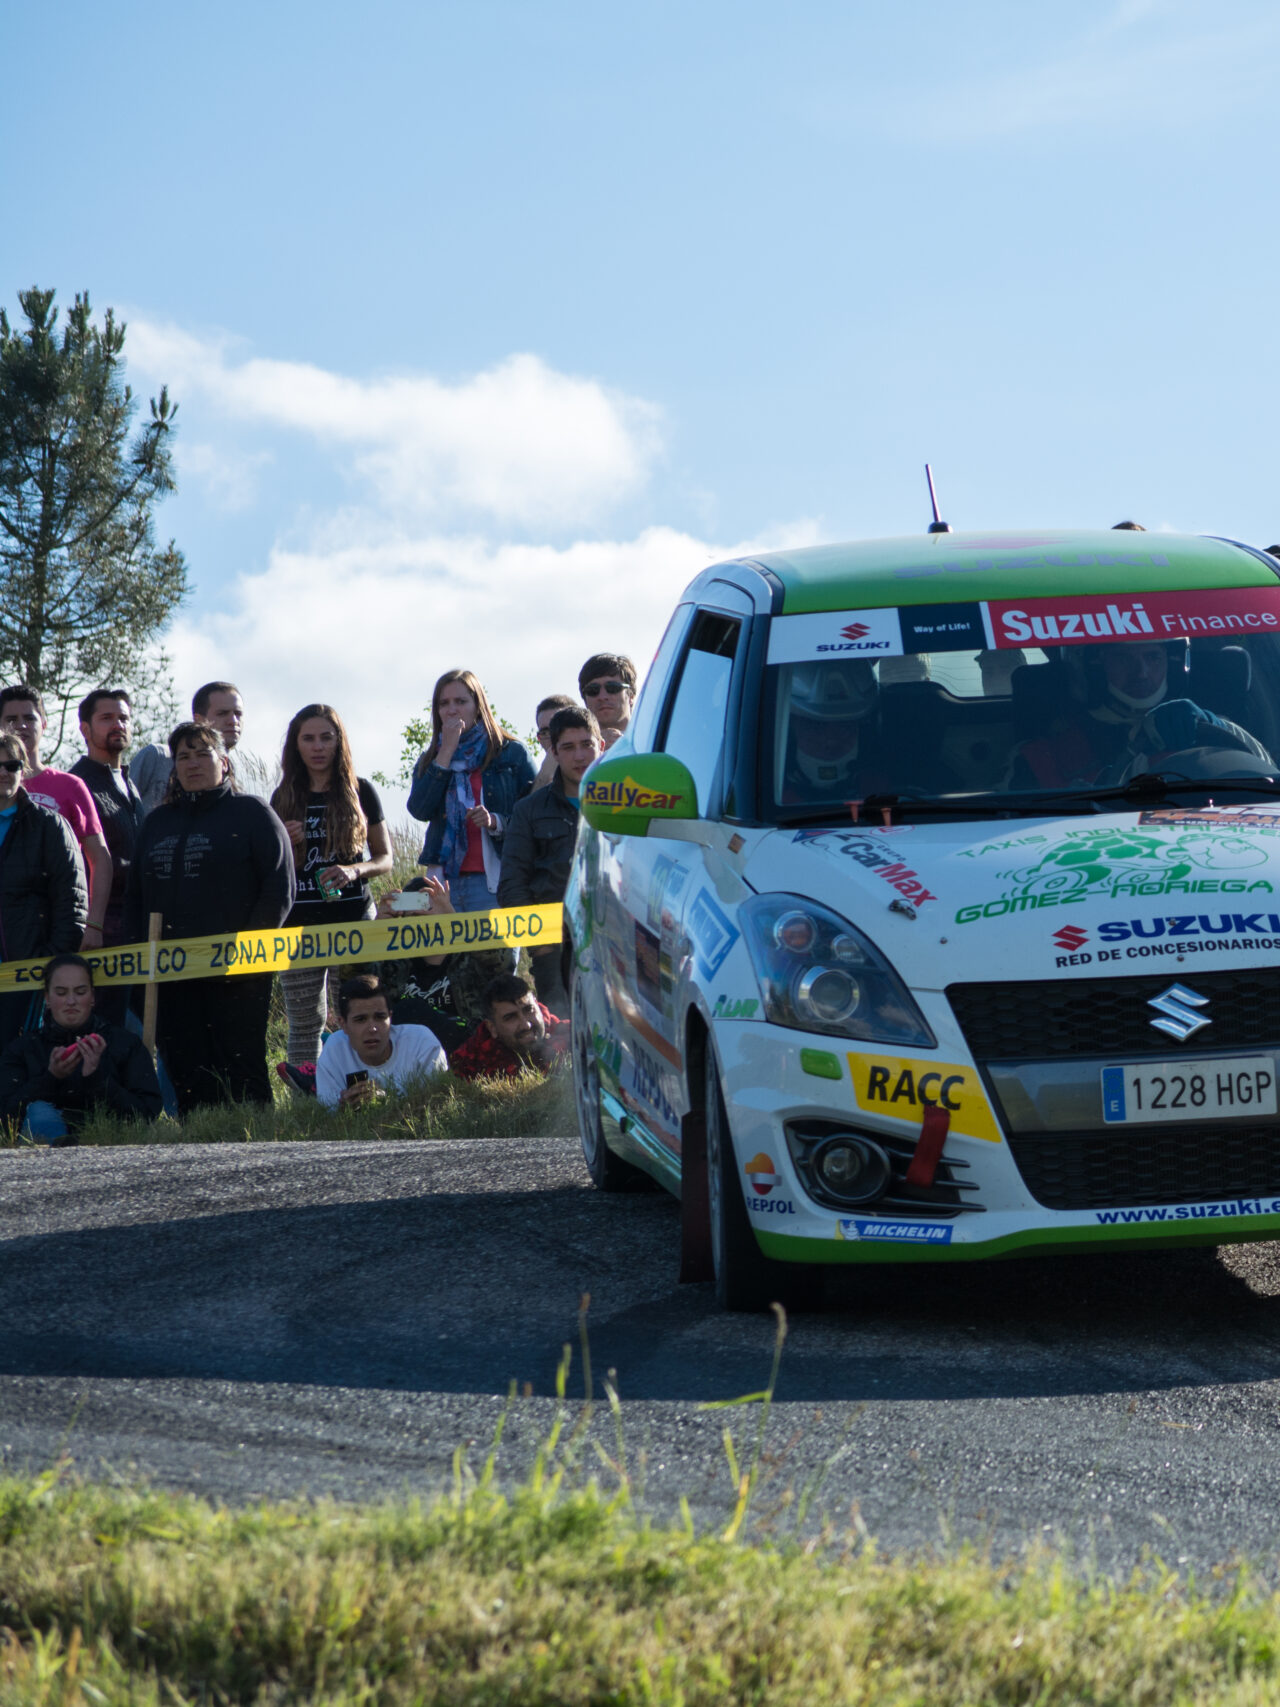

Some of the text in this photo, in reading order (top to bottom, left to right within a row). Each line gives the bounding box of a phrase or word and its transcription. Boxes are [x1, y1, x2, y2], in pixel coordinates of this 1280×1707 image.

[893, 553, 1170, 579] SUZUKI
[913, 622, 971, 634] Way of Life!
[1001, 603, 1279, 641] Suzuki Finance
[816, 641, 890, 652] SUZUKI
[586, 781, 683, 809] Rallycar
[957, 834, 1048, 858] TAXIS
[840, 843, 939, 908] CarMax
[387, 913, 543, 951] ZONA PUBLICO
[87, 947, 186, 978] PUBLCO
[210, 929, 364, 967] ZONA PUBLICO
[1056, 952, 1093, 968] RED
[1098, 948, 1122, 962] DE
[867, 1065, 965, 1111] RACC
[1110, 1071, 1272, 1112] E 1228 HGP
[863, 1224, 947, 1239] MICHELIN
